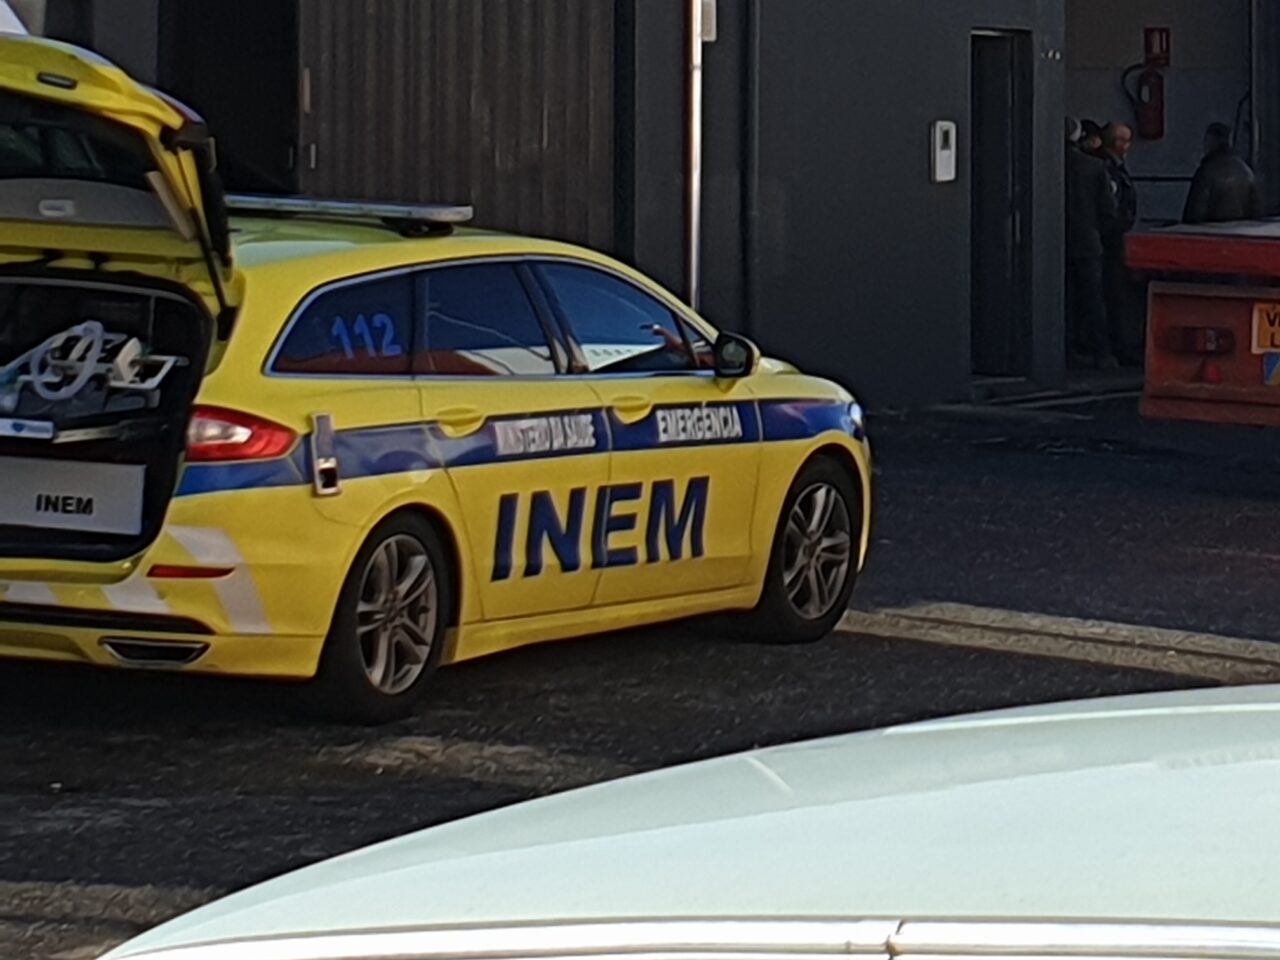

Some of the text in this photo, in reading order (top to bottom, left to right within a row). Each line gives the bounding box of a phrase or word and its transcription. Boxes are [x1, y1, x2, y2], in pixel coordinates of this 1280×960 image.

[331, 314, 402, 359] 112
[36, 494, 94, 515] INEM
[491, 475, 710, 582] INEM
